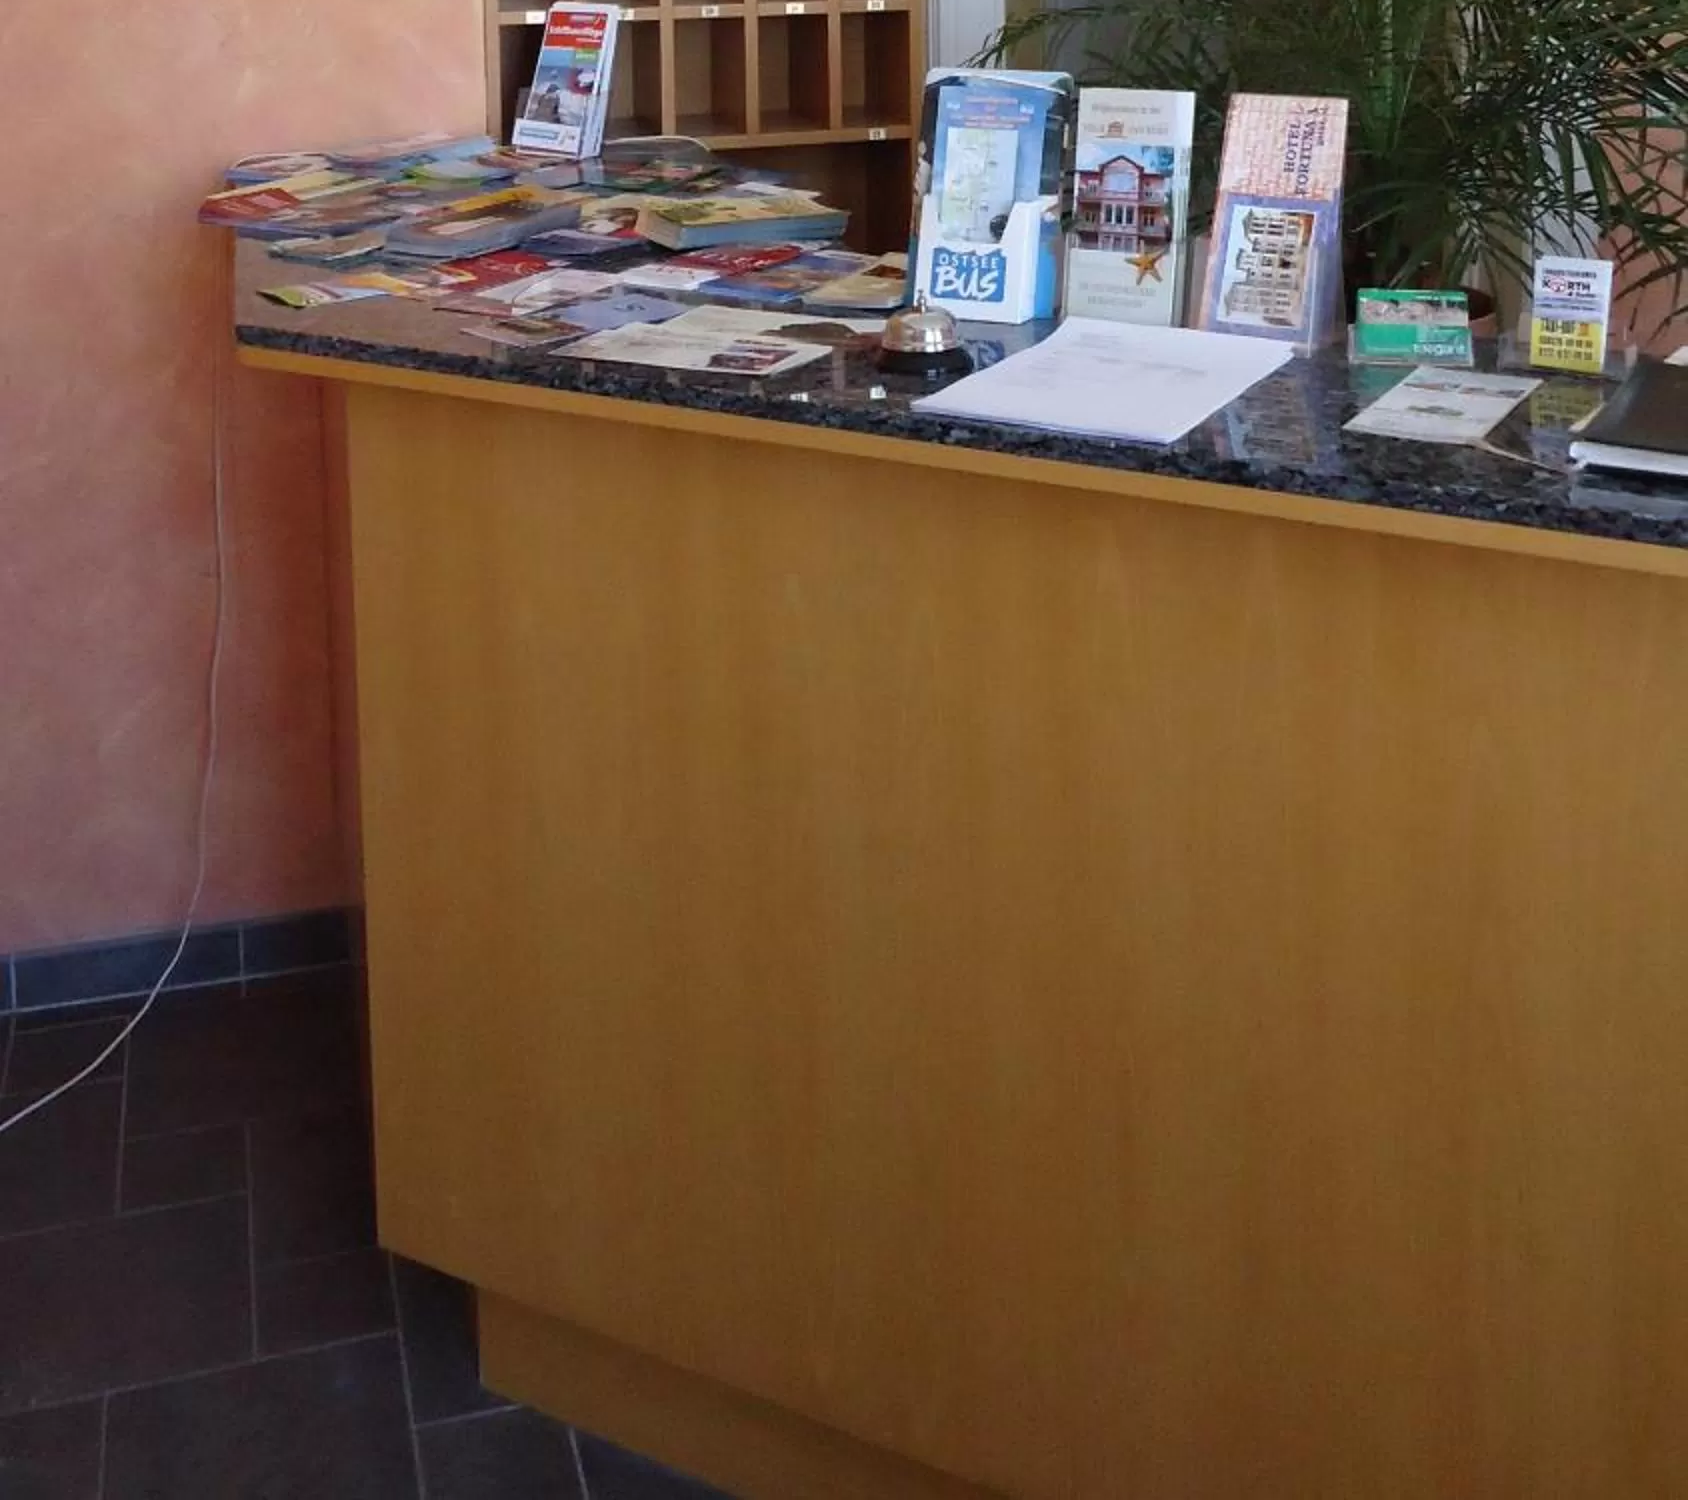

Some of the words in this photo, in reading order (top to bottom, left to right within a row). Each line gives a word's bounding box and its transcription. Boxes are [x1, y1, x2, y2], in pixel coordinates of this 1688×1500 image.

[1284, 122, 1301, 173] HOTEL
[1294, 120, 1317, 196] FORTUNA
[939, 253, 999, 269] OSTSEE
